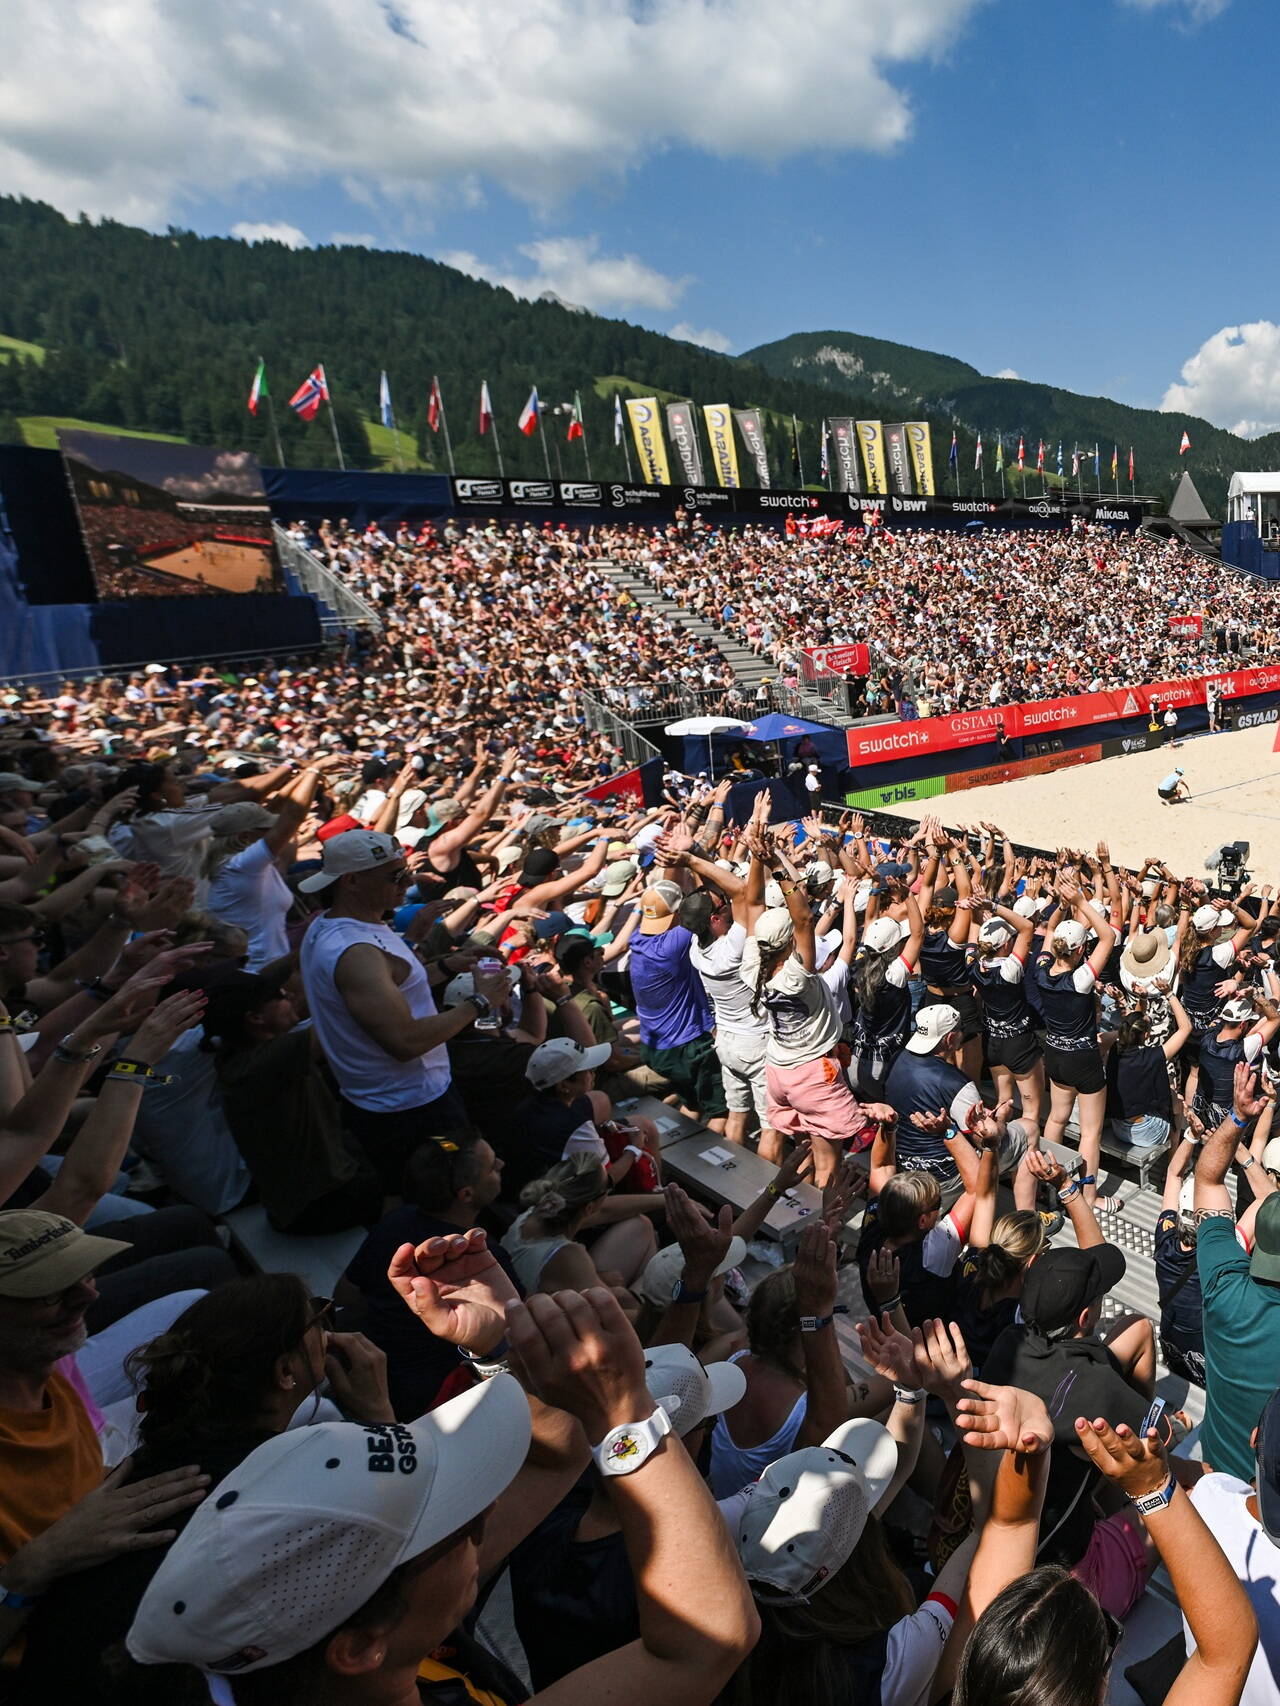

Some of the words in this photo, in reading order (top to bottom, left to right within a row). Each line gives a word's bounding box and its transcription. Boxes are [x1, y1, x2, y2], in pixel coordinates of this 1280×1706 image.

[760, 495, 809, 508] swatch
[860, 500, 886, 511] BWT
[904, 501, 928, 512] BWT
[952, 502, 989, 512] swatch
[1096, 506, 1130, 520] MIKASA
[1157, 689, 1187, 702] watch
[951, 711, 1004, 732] GSTAAD
[1024, 707, 1070, 726] swatch
[1238, 709, 1279, 728] GSTAAD
[859, 730, 919, 755] swatch
[895, 786, 916, 800] bls
